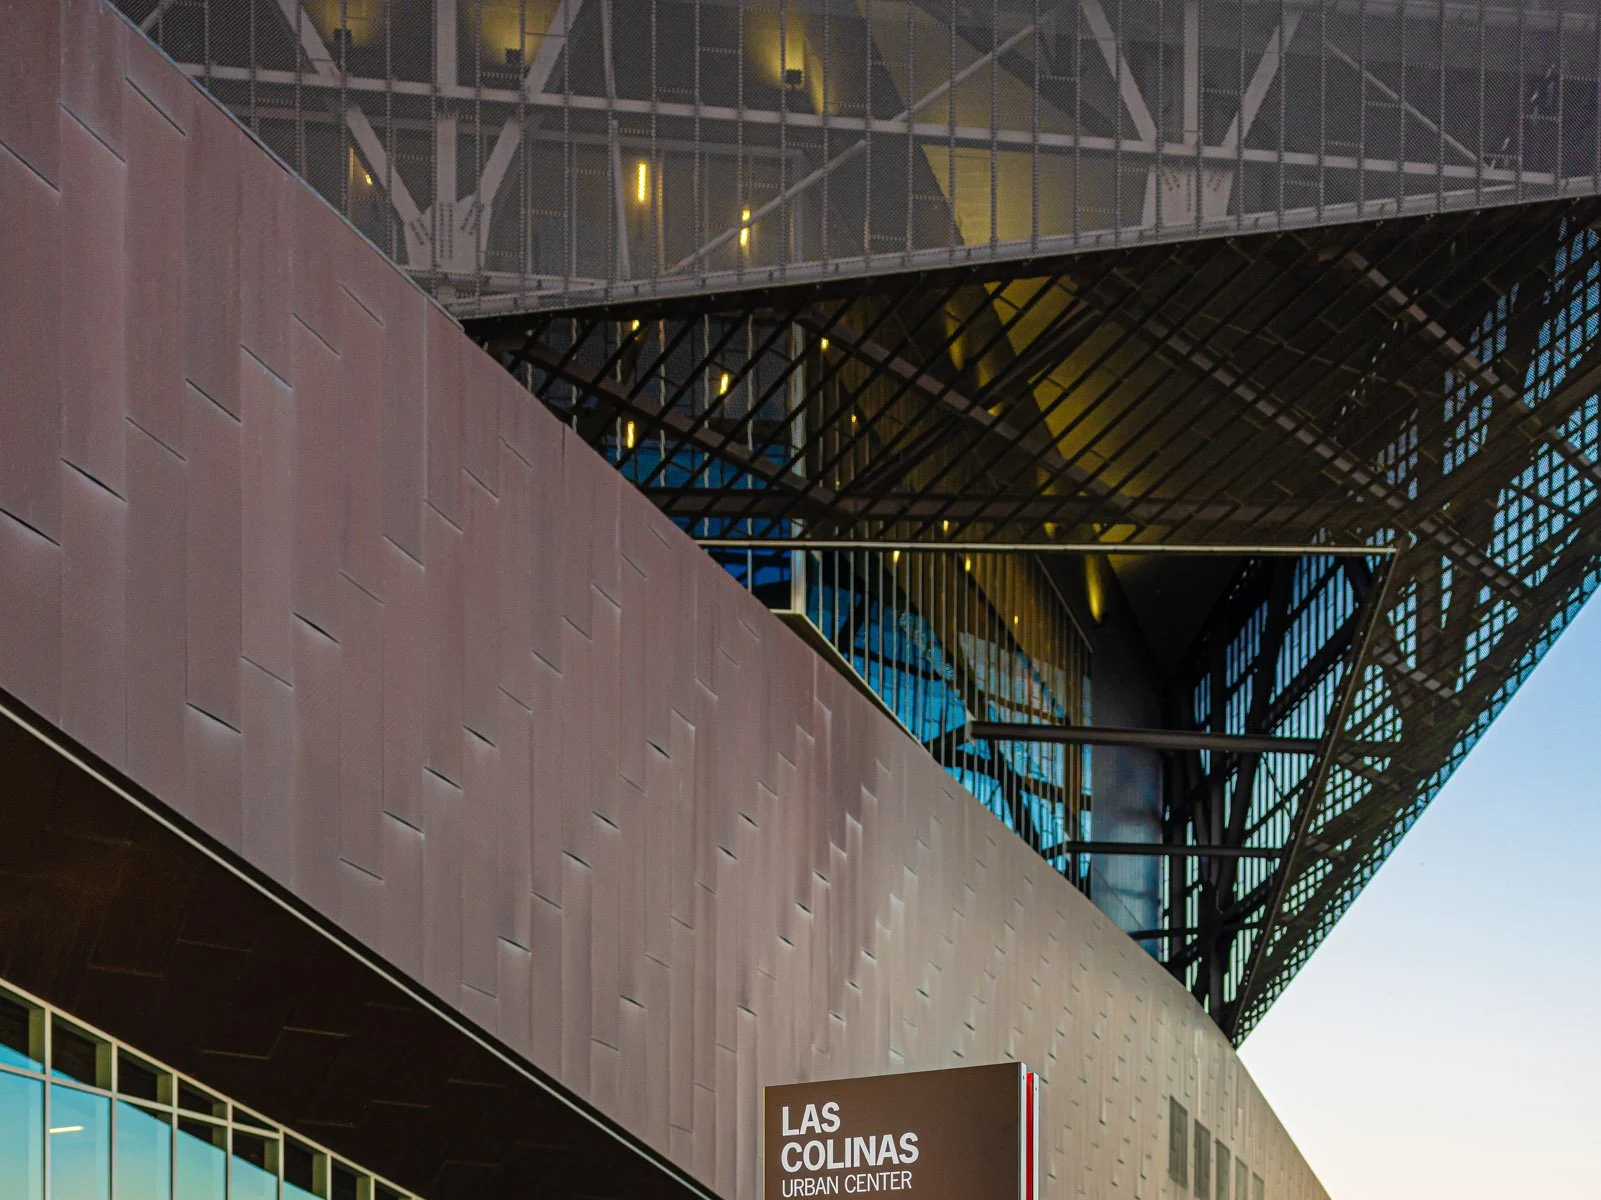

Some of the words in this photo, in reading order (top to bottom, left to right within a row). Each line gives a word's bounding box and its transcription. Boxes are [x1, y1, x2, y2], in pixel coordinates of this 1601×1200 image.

[782, 1101, 841, 1136] LAS
[781, 1132, 920, 1173] COLINAS
[782, 1175, 839, 1198] URBAN
[844, 1170, 912, 1194] CENTER
